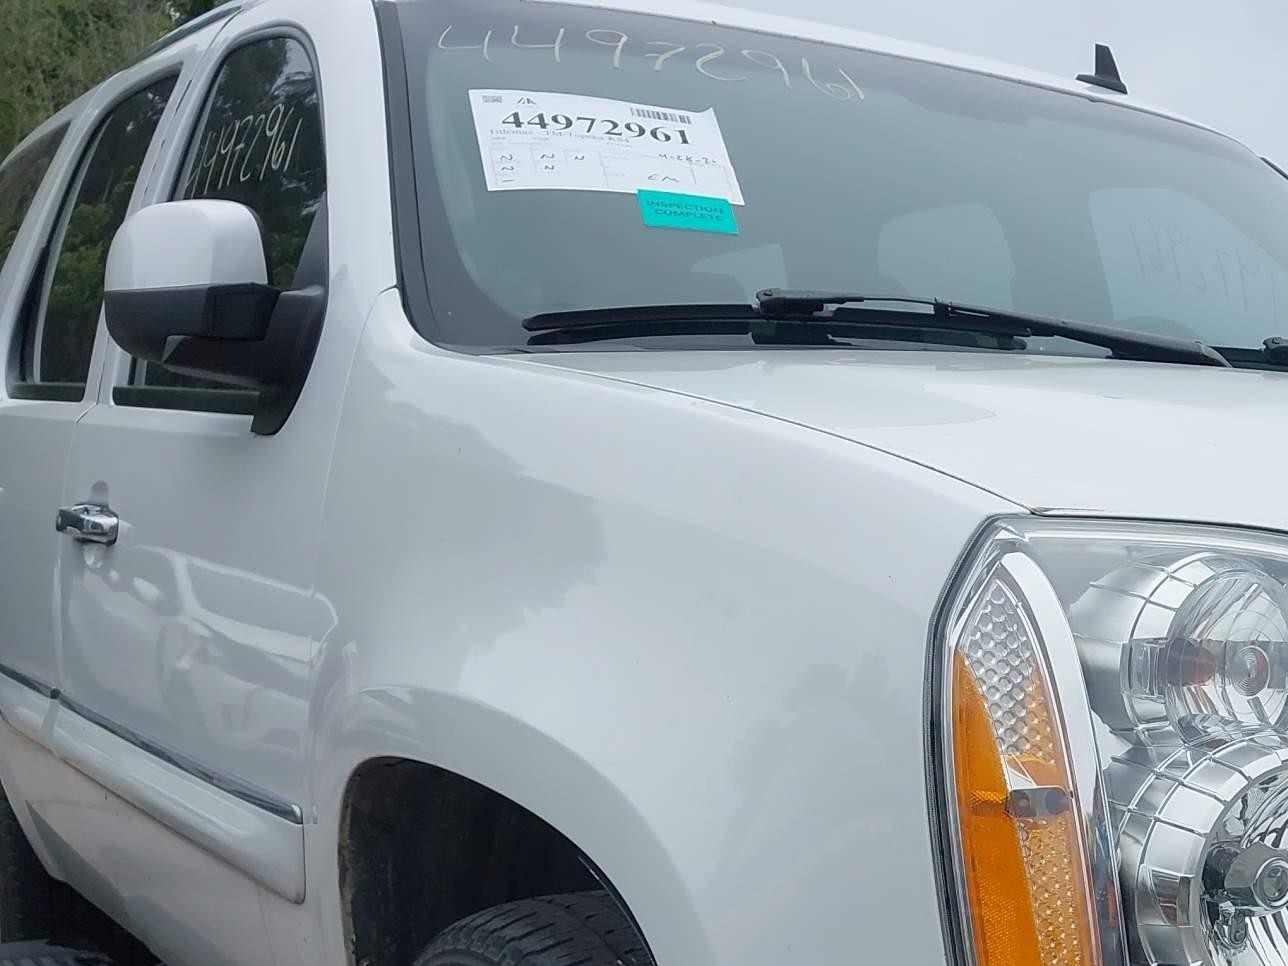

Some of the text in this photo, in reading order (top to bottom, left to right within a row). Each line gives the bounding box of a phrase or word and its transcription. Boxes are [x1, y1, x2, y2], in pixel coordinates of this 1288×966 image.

[438, 24, 865, 101] 44972961
[501, 111, 691, 145] 44972961
[646, 200, 724, 214] INSPECTION
[655, 208, 724, 222] COMPLETE
